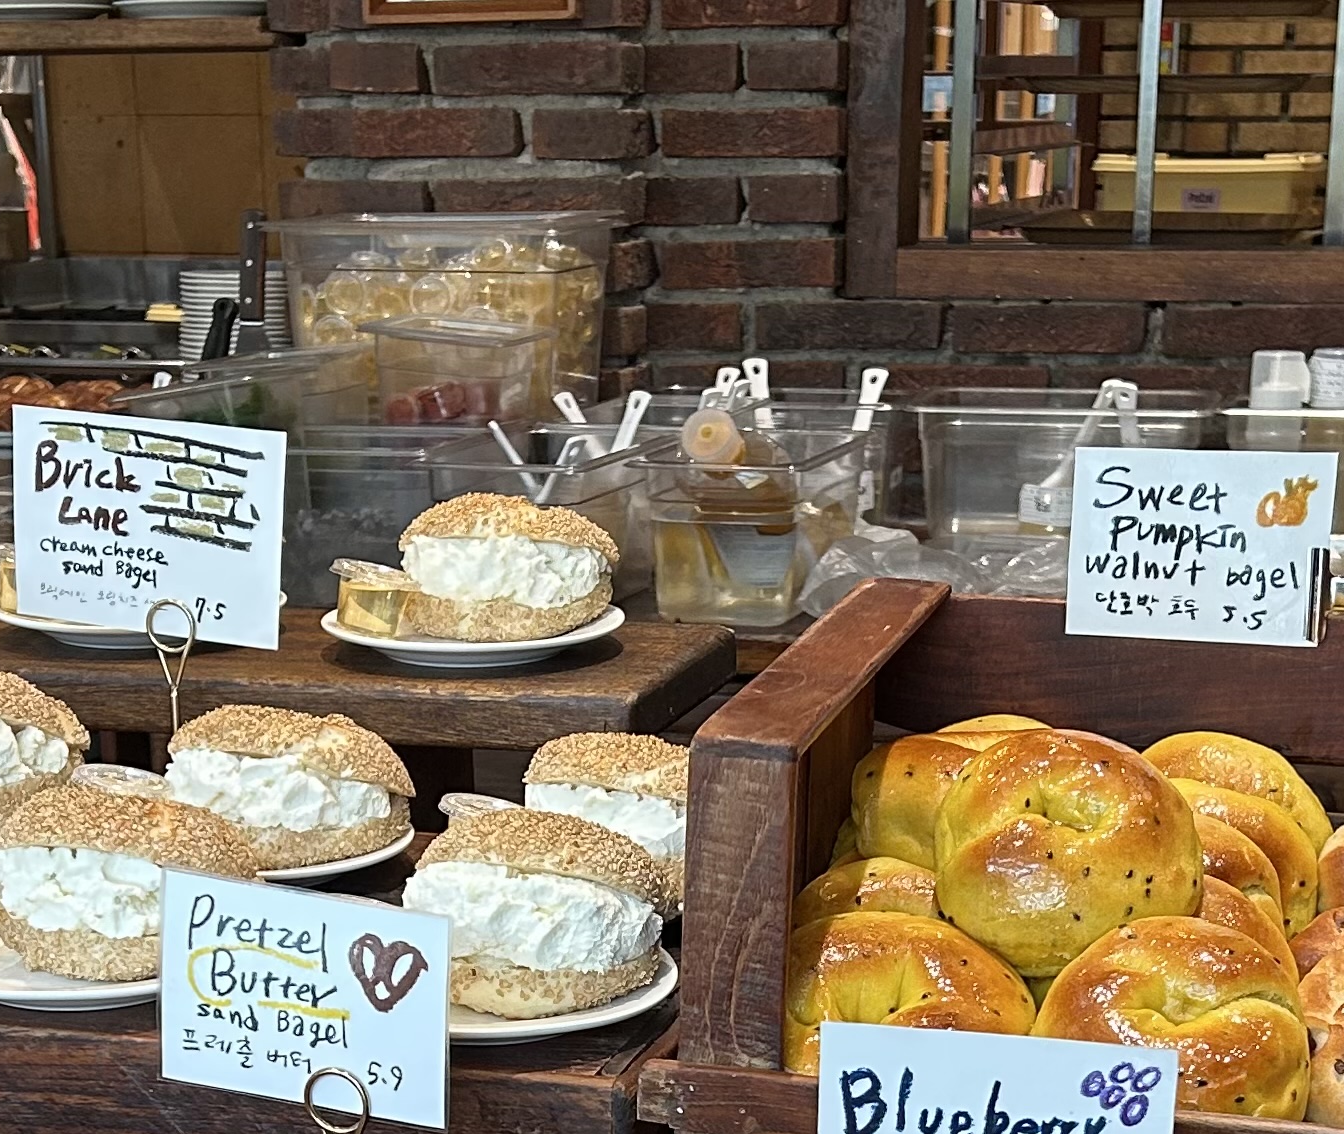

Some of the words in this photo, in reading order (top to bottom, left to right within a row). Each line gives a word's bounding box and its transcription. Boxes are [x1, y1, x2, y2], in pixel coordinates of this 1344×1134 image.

[35, 439, 141, 492] Brick
[1093, 466, 1228, 514] Sweet
[58, 496, 130, 537] Lane
[63, 560, 104, 577] sand
[115, 562, 158, 588] Bagel
[103, 541, 169, 566] cheese
[195, 597, 228, 623] 7.5
[1095, 590, 1160, 616] 단호박
[1168, 595, 1199, 620] 호두
[1222, 605, 1267, 630] 5.5
[188, 894, 328, 973] Pretzel
[211, 948, 338, 1009] Butter
[197, 1003, 259, 1032] sand
[277, 1010, 348, 1048] Bagel
[182, 1029, 254, 1068] 프레츨
[267, 1050, 312, 1074] 버터
[367, 1061, 403, 1091] 5.9
